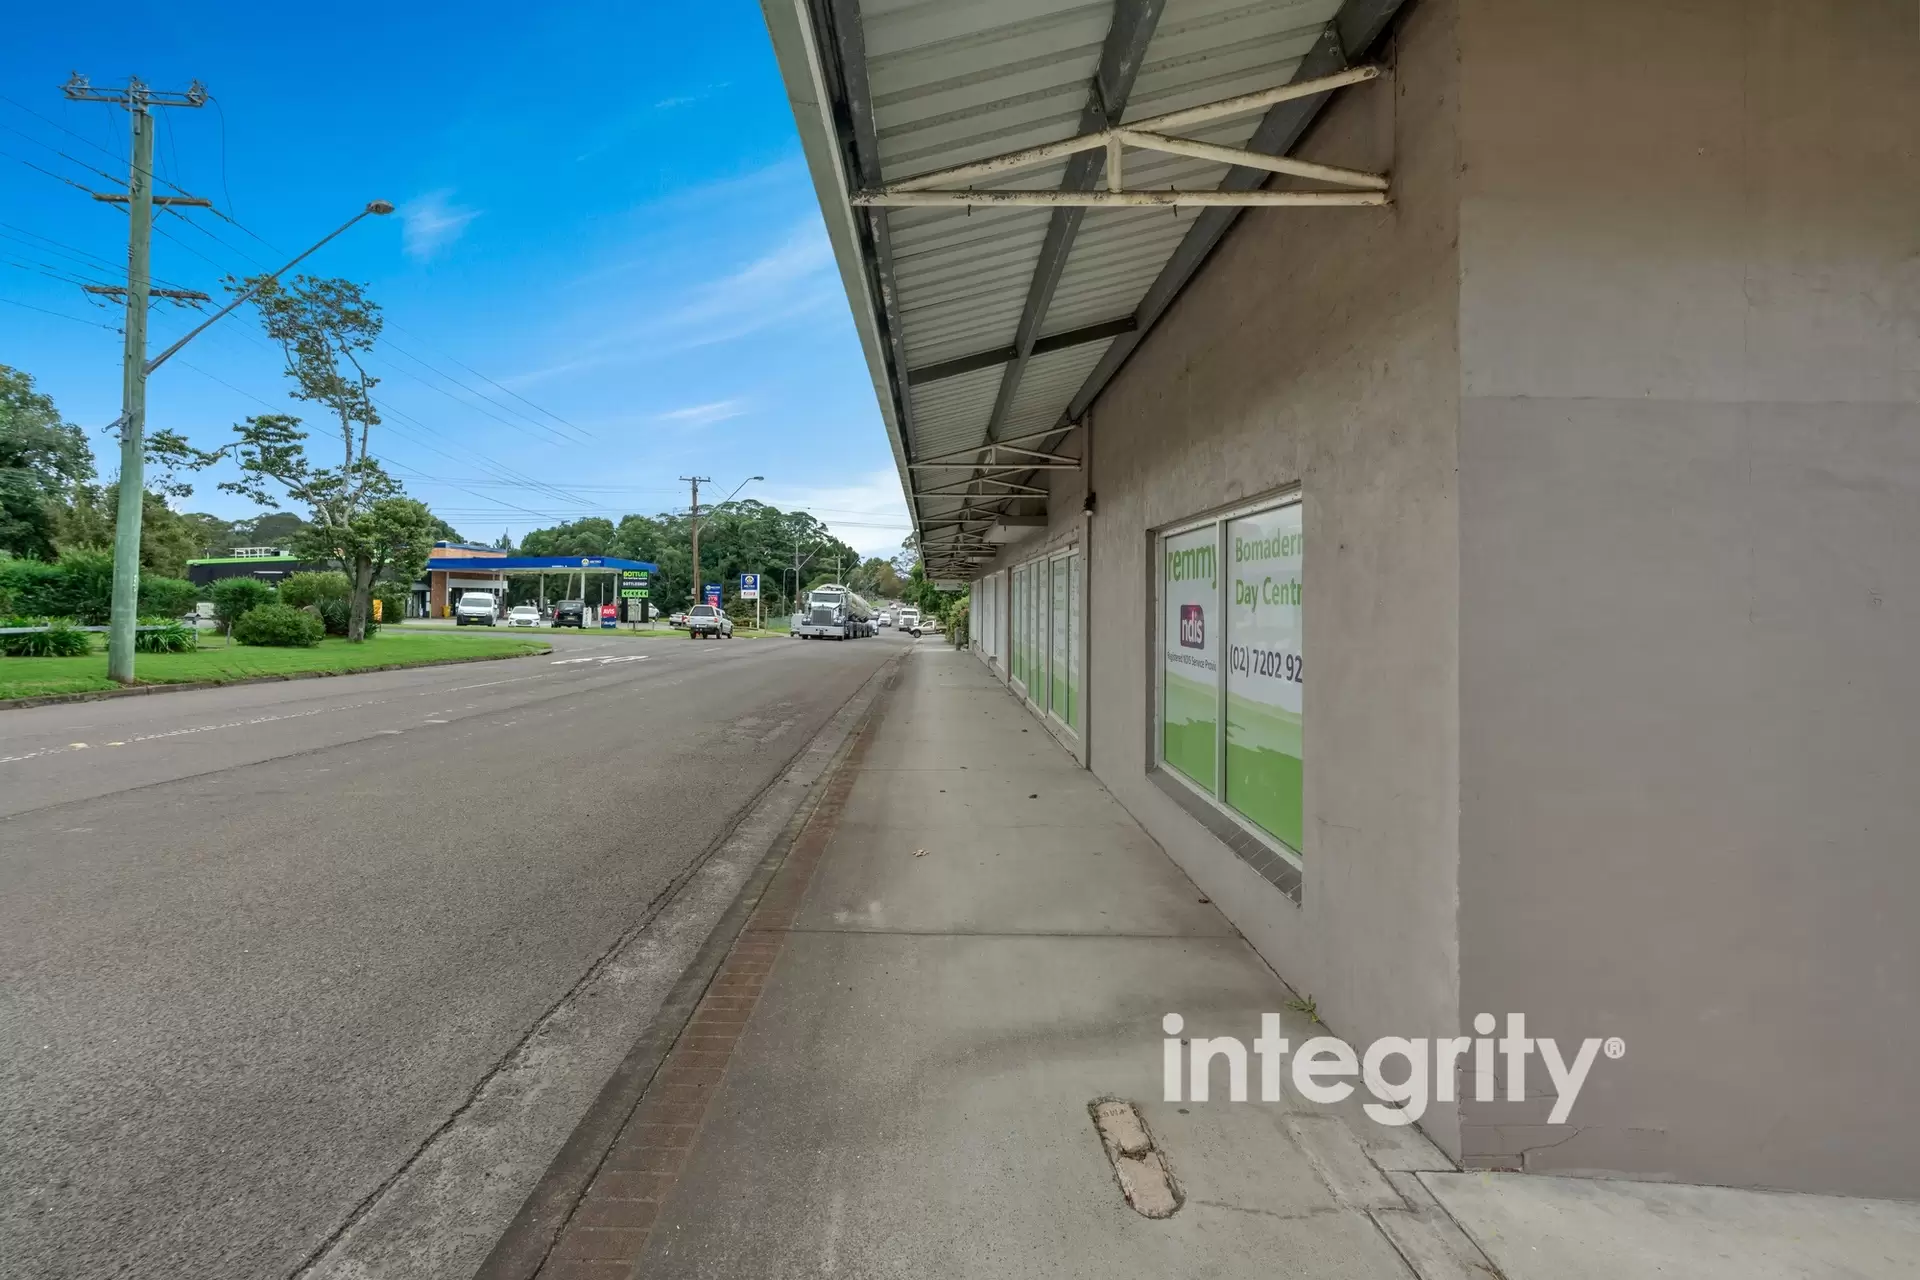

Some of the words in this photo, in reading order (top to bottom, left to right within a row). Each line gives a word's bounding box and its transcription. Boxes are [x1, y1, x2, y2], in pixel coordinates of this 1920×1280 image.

[1235, 579, 1259, 613] Day
[1181, 609, 1203, 644] ndis
[1229, 644, 1250, 678] (02)
[1253, 649, 1282, 679] 7202
[1286, 654, 1303, 684] 92
